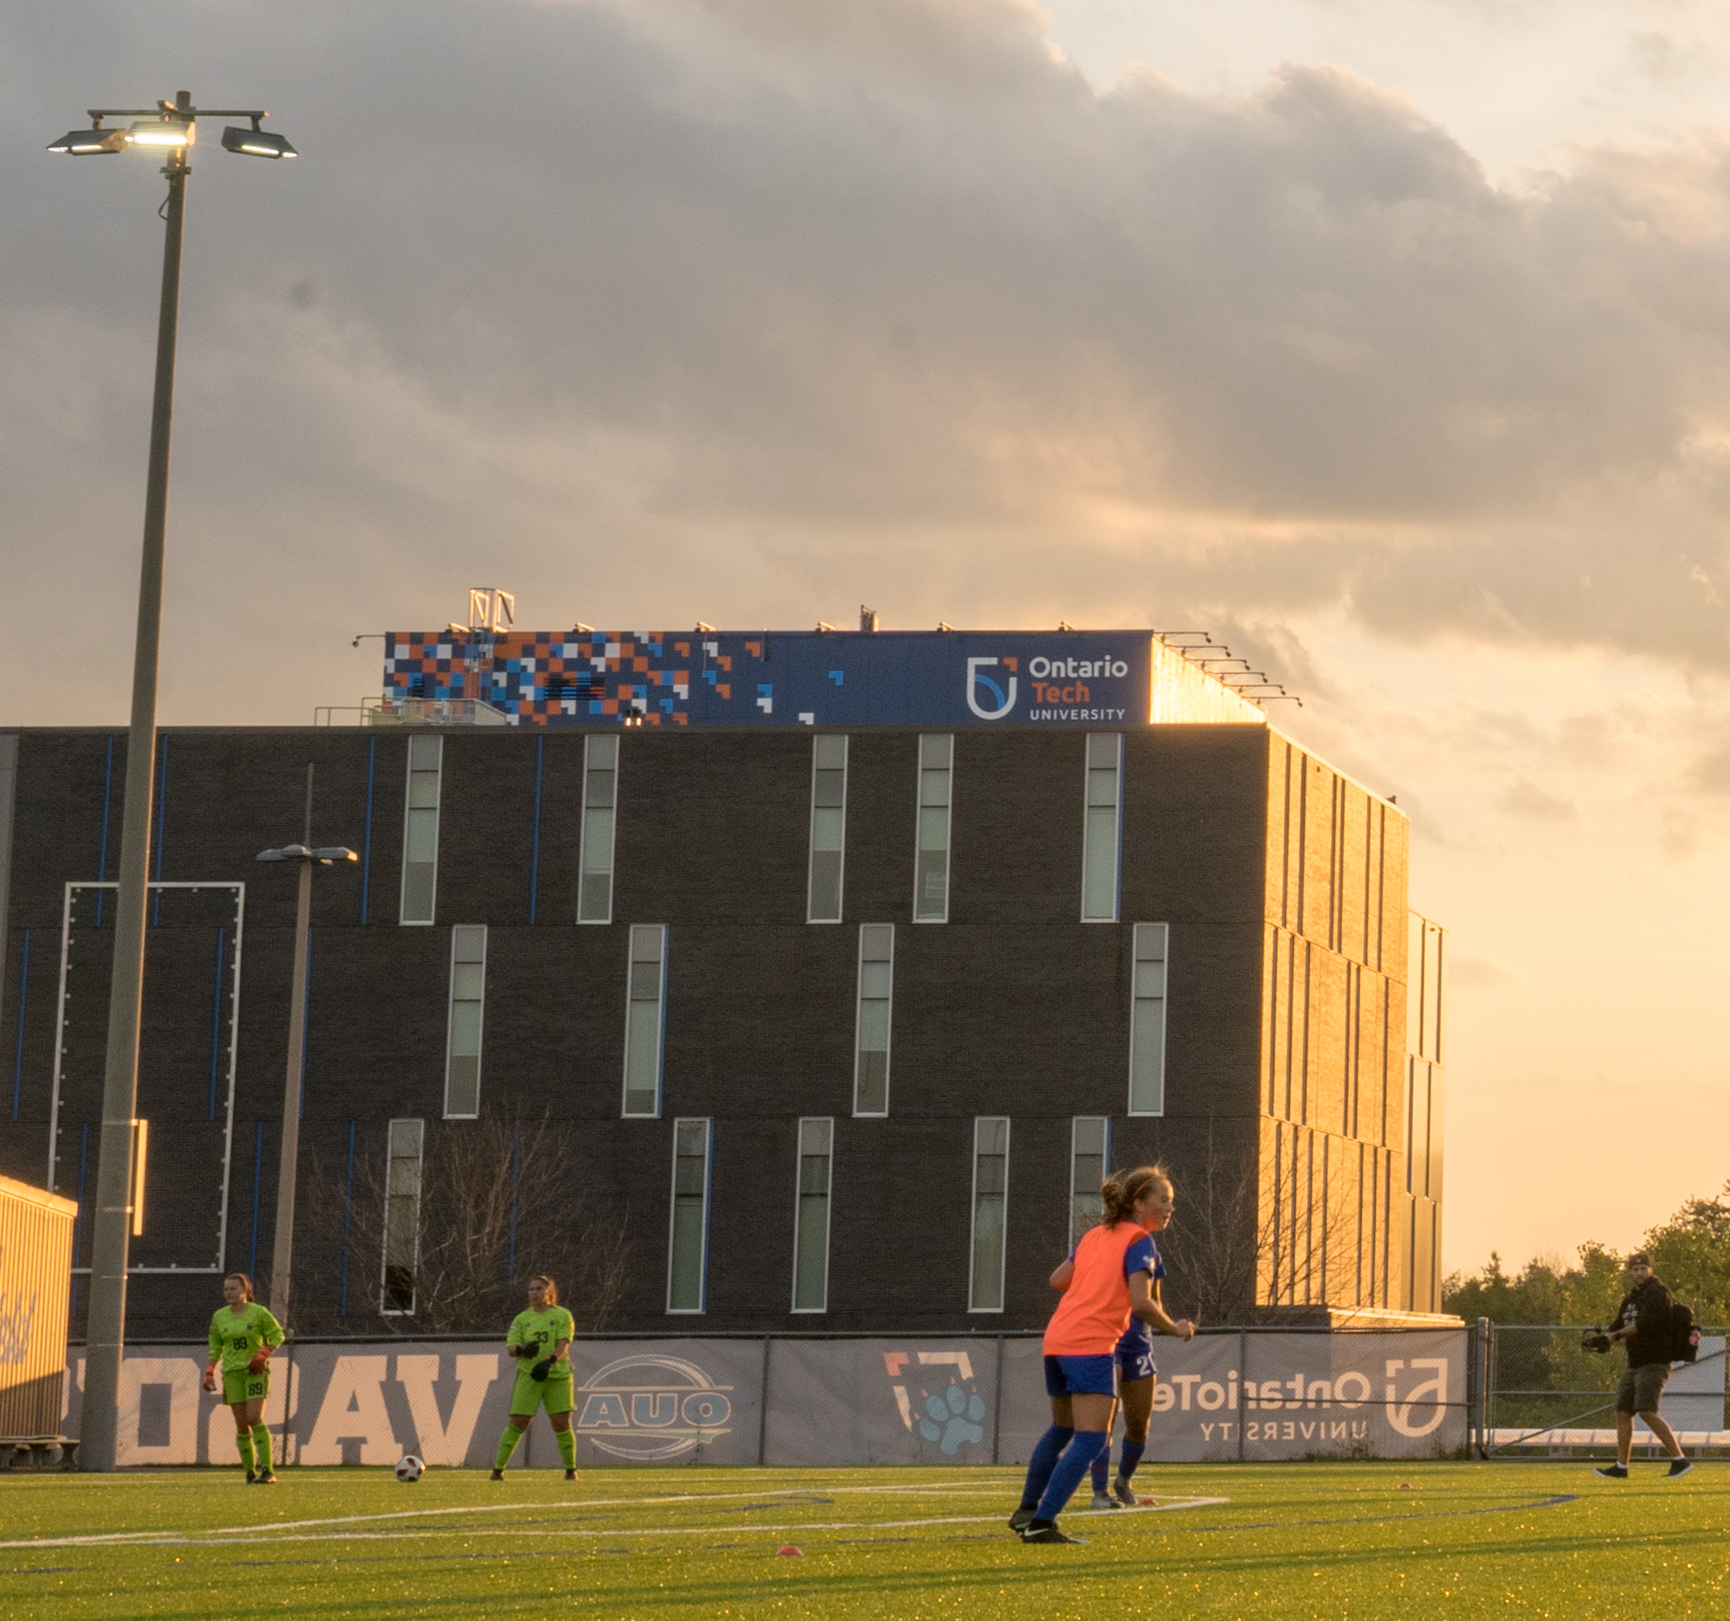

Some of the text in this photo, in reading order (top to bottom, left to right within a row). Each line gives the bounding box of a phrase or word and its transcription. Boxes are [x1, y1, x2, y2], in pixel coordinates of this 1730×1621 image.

[1029, 655, 1128, 678] Ontario
[1031, 680, 1090, 703] Tech
[1030, 709, 1125, 721] UNIVERSITY
[233, 1337, 247, 1350] 89
[534, 1331, 549, 1343] 33
[249, 1382, 263, 1395] 89
